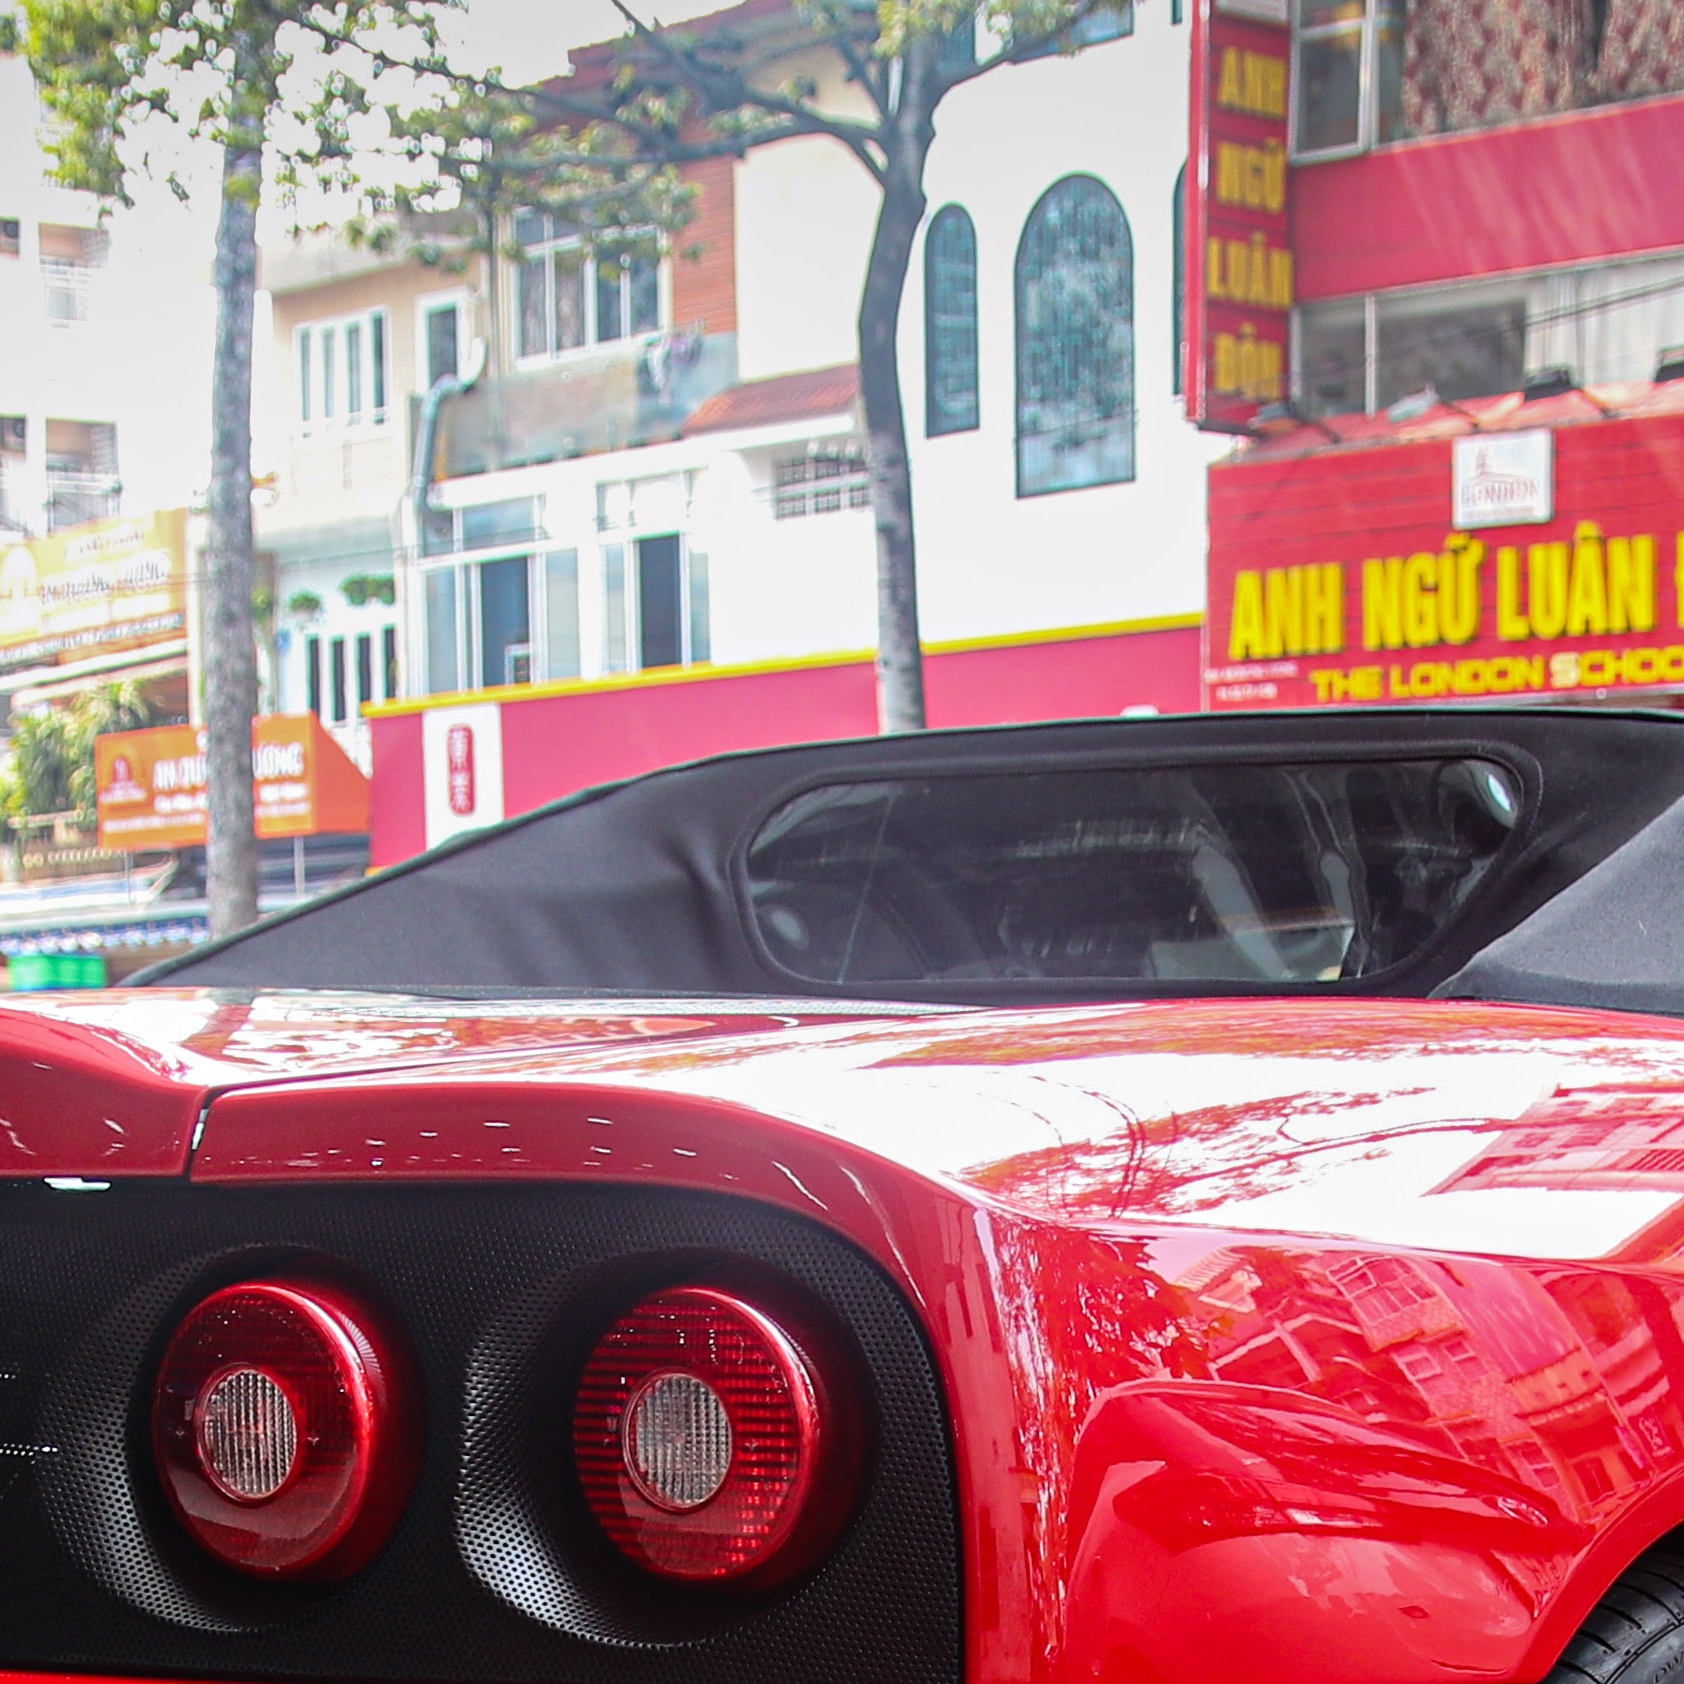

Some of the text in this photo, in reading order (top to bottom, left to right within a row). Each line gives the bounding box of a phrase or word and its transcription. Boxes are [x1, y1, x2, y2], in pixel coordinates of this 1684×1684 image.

[1207, 231, 1293, 307] LUÂN
[1229, 562, 1345, 660] ANH
[1362, 532, 1488, 652] NGỮ
[1497, 519, 1657, 641] LUÂN
[1310, 666, 1384, 701] THE
[1390, 654, 1546, 698] LONDON
